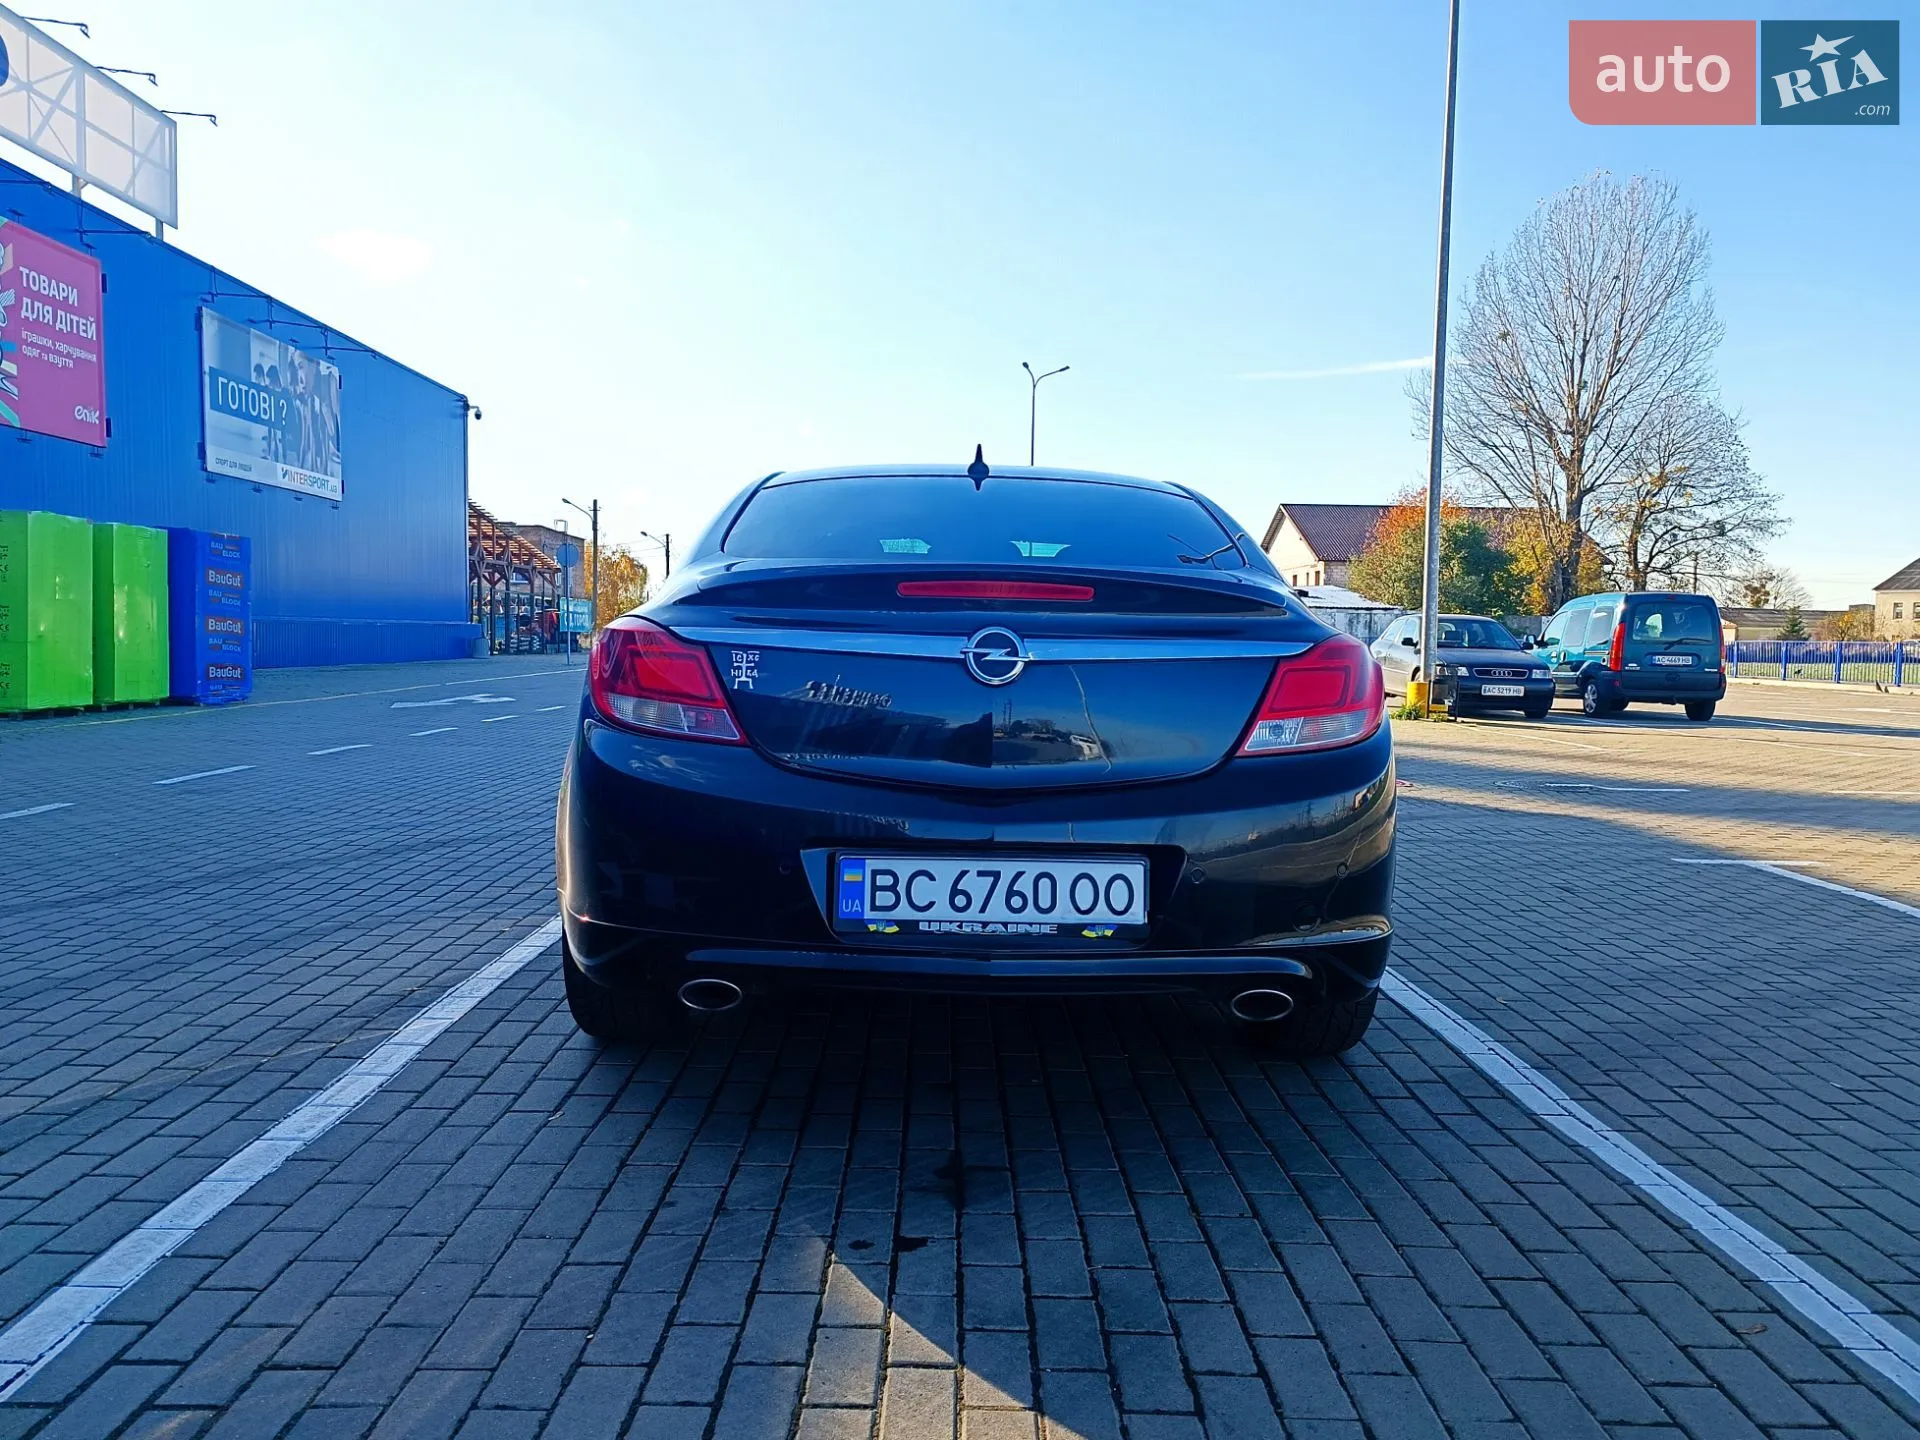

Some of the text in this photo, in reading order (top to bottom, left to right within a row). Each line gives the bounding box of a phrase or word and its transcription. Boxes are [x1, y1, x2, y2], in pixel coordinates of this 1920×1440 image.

[19, 266, 78, 307] ТОВАРИ
[21, 297, 96, 340] ДЛЯ ДІТЕЙ
[21, 327, 97, 362] іграшки, харчування
[22, 345, 40, 358] одяг
[48, 353, 74, 368] взуття
[218, 376, 287, 425] ГОТОВІ ?
[208, 570, 241, 587] BauGut
[208, 618, 241, 633] BauGut
[209, 667, 241, 679] BauGut
[869, 868, 1135, 916] BC 6760 OO
[842, 898, 862, 913] UA
[919, 921, 1058, 934] UKRAINE
